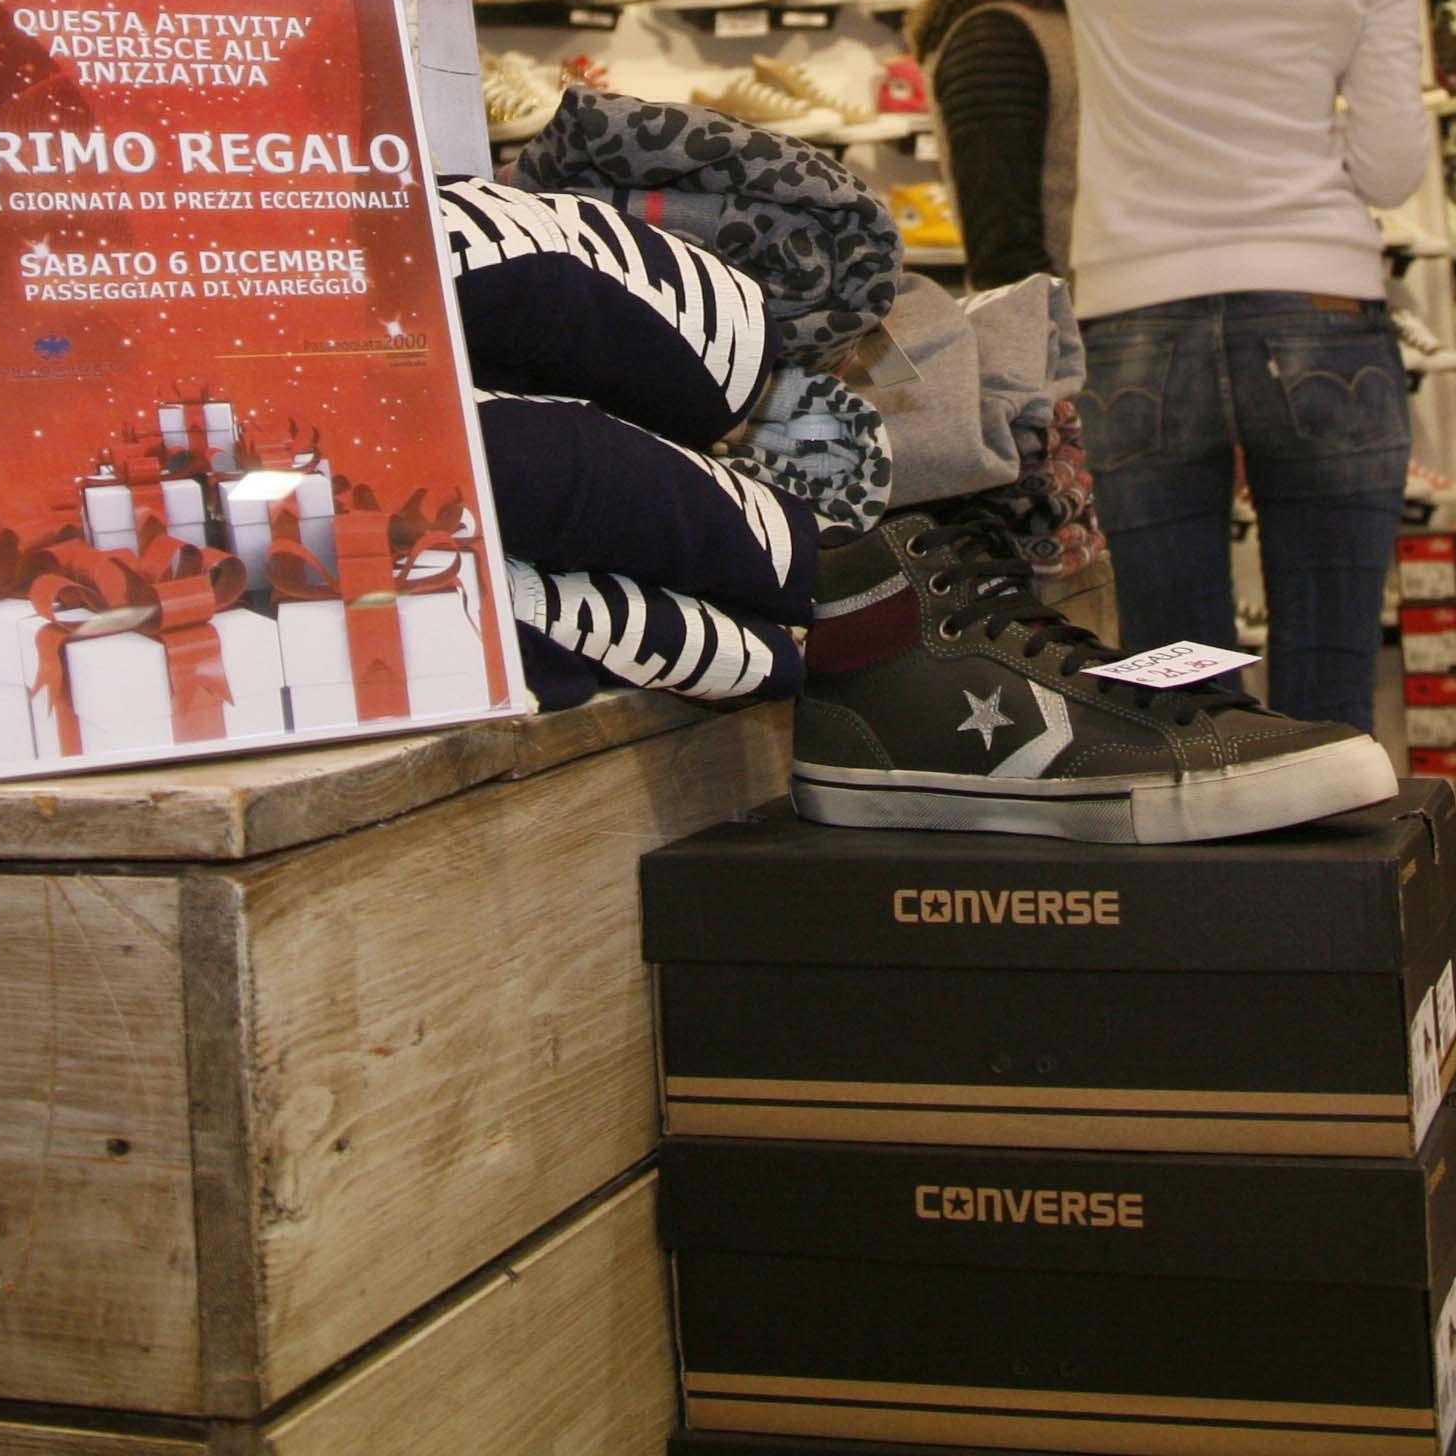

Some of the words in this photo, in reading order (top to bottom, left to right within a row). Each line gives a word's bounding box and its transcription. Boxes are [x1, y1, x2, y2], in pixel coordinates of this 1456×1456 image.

[13, 8, 141, 36] QUESTA
[154, 12, 312, 39] ATTIVITA'
[49, 35, 213, 60] ADERISCE
[223, 40, 288, 63] ALL'
[77, 60, 269, 87] INIZIATIVA
[178, 132, 412, 175] REGALO
[8, 190, 133, 211] GIORNATA
[140, 191, 167, 210] DI
[174, 191, 252, 210] PREZZI
[260, 190, 411, 210] ECCEZIONALI!
[19, 250, 158, 279] SABATO
[168, 251, 188, 276] 6
[200, 249, 367, 275] DICEMBRE
[24, 280, 196, 302] PASSEGGIATA
[203, 280, 231, 299] DI
[238, 278, 368, 298] VIAREGGIO
[1103, 646, 1194, 674] REGALO
[894, 889, 1121, 925] CONVERSE
[915, 1185, 1144, 1228] CONVERSE
